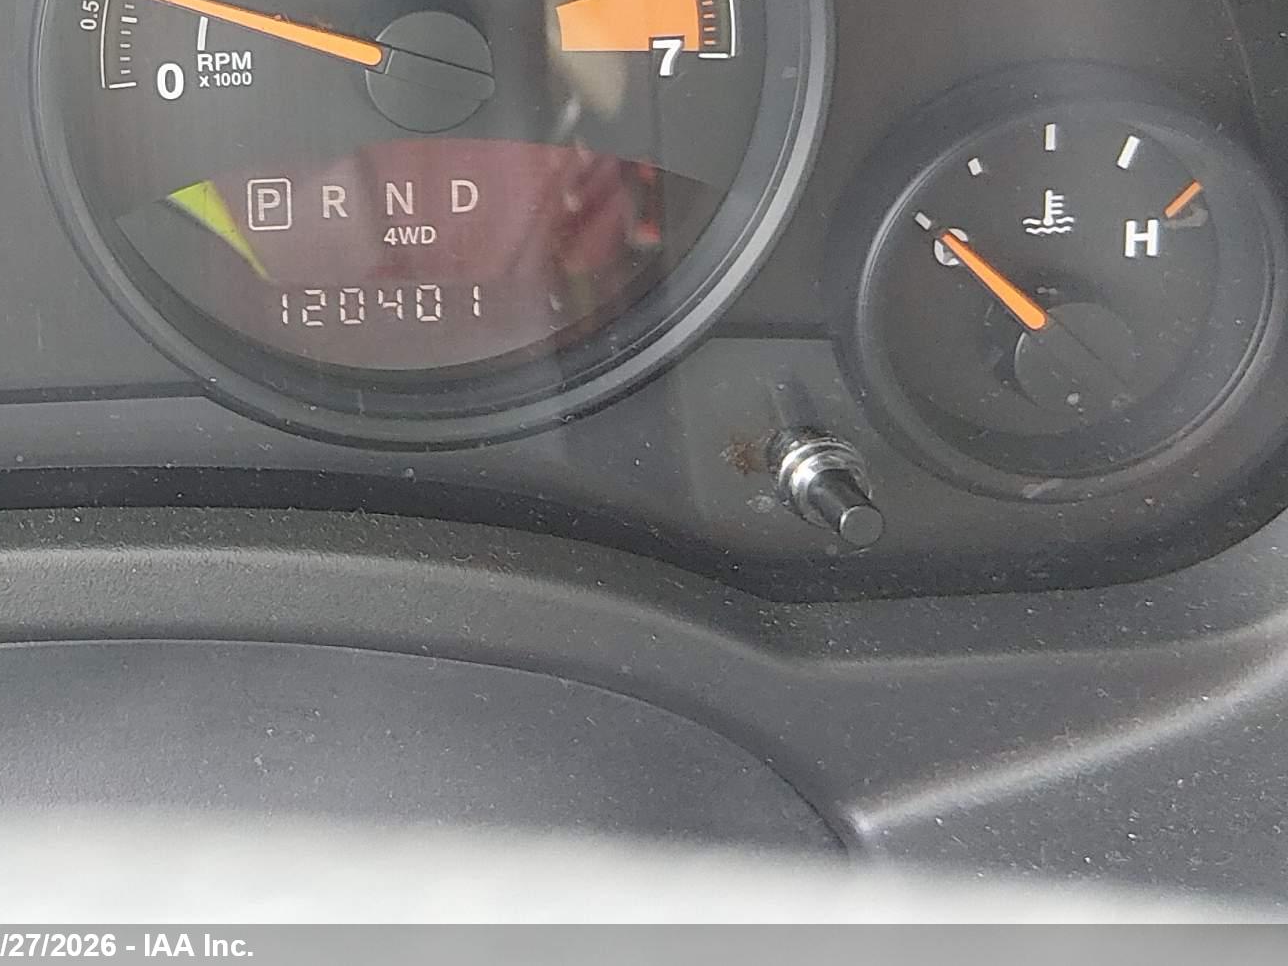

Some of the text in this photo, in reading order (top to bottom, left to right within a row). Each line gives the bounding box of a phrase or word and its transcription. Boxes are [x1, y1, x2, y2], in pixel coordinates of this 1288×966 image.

[79, 0, 100, 30] 0.5
[196, 50, 254, 73] RPM
[652, 38, 685, 77] 7
[156, 62, 185, 100] 0
[257, 179, 479, 222] P R N D
[383, 225, 437, 246] 4WD
[1124, 219, 1160, 258] H
[281, 284, 481, 326] 120401
